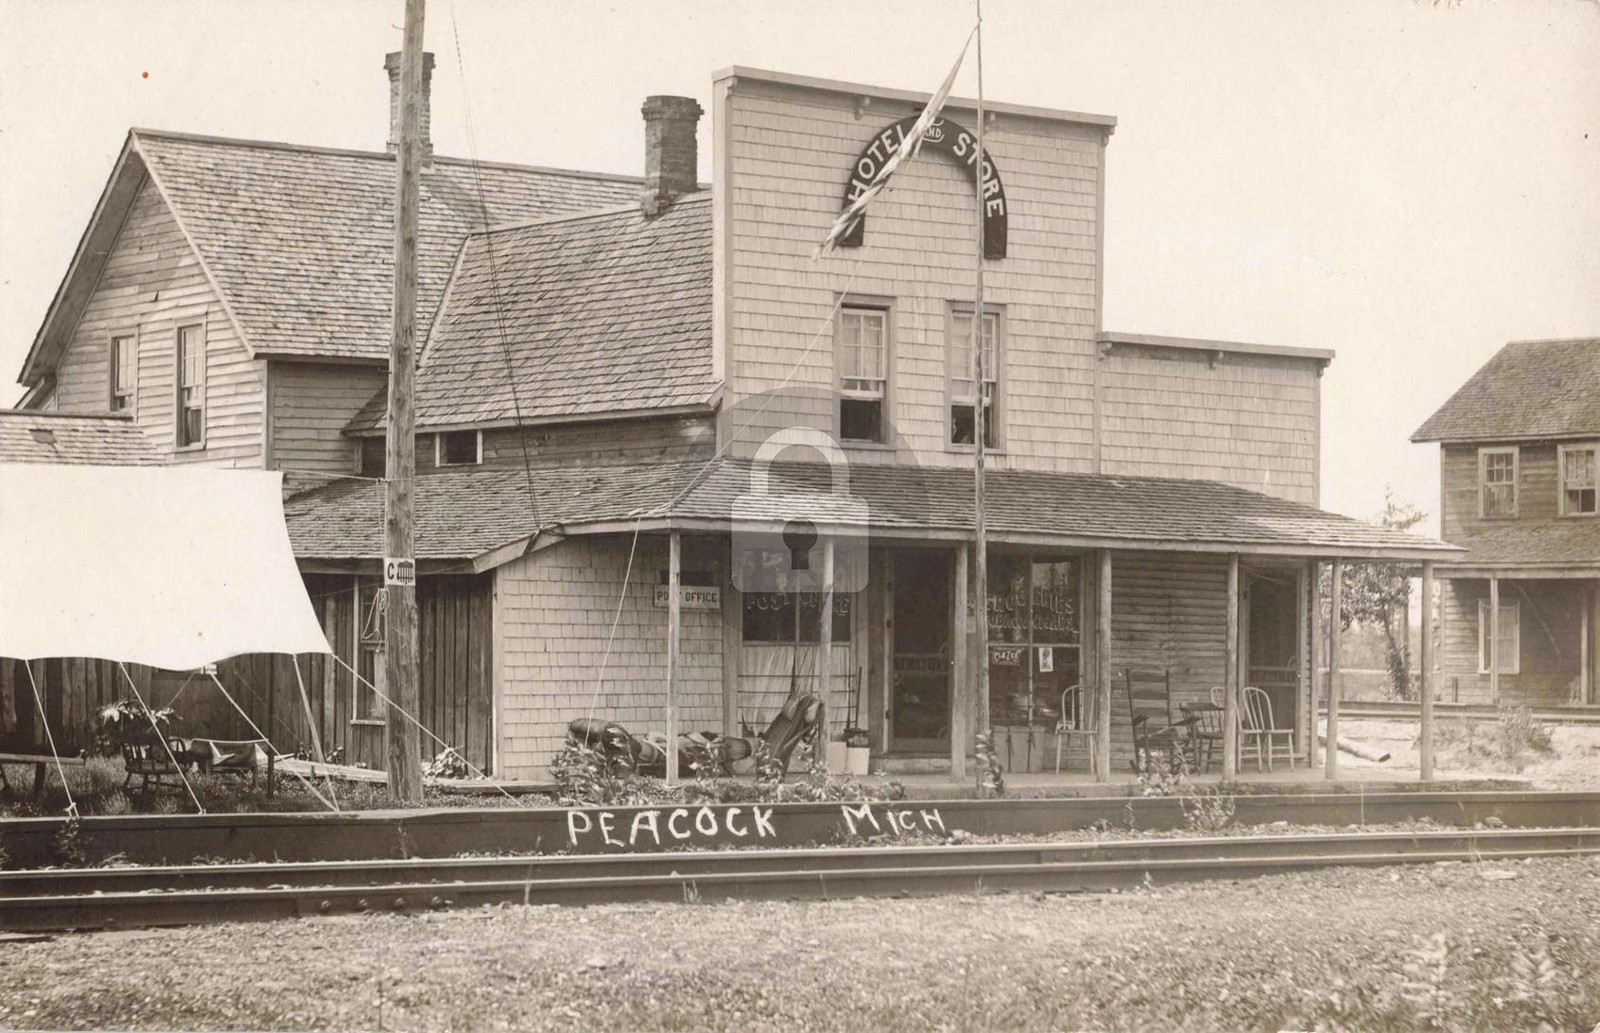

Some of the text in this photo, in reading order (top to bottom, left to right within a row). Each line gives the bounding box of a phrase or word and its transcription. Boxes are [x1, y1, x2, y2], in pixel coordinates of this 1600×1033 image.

[848, 124, 906, 202] HOTEL
[953, 132, 1004, 218] STORE
[656, 592, 718, 603] PO OFFICE
